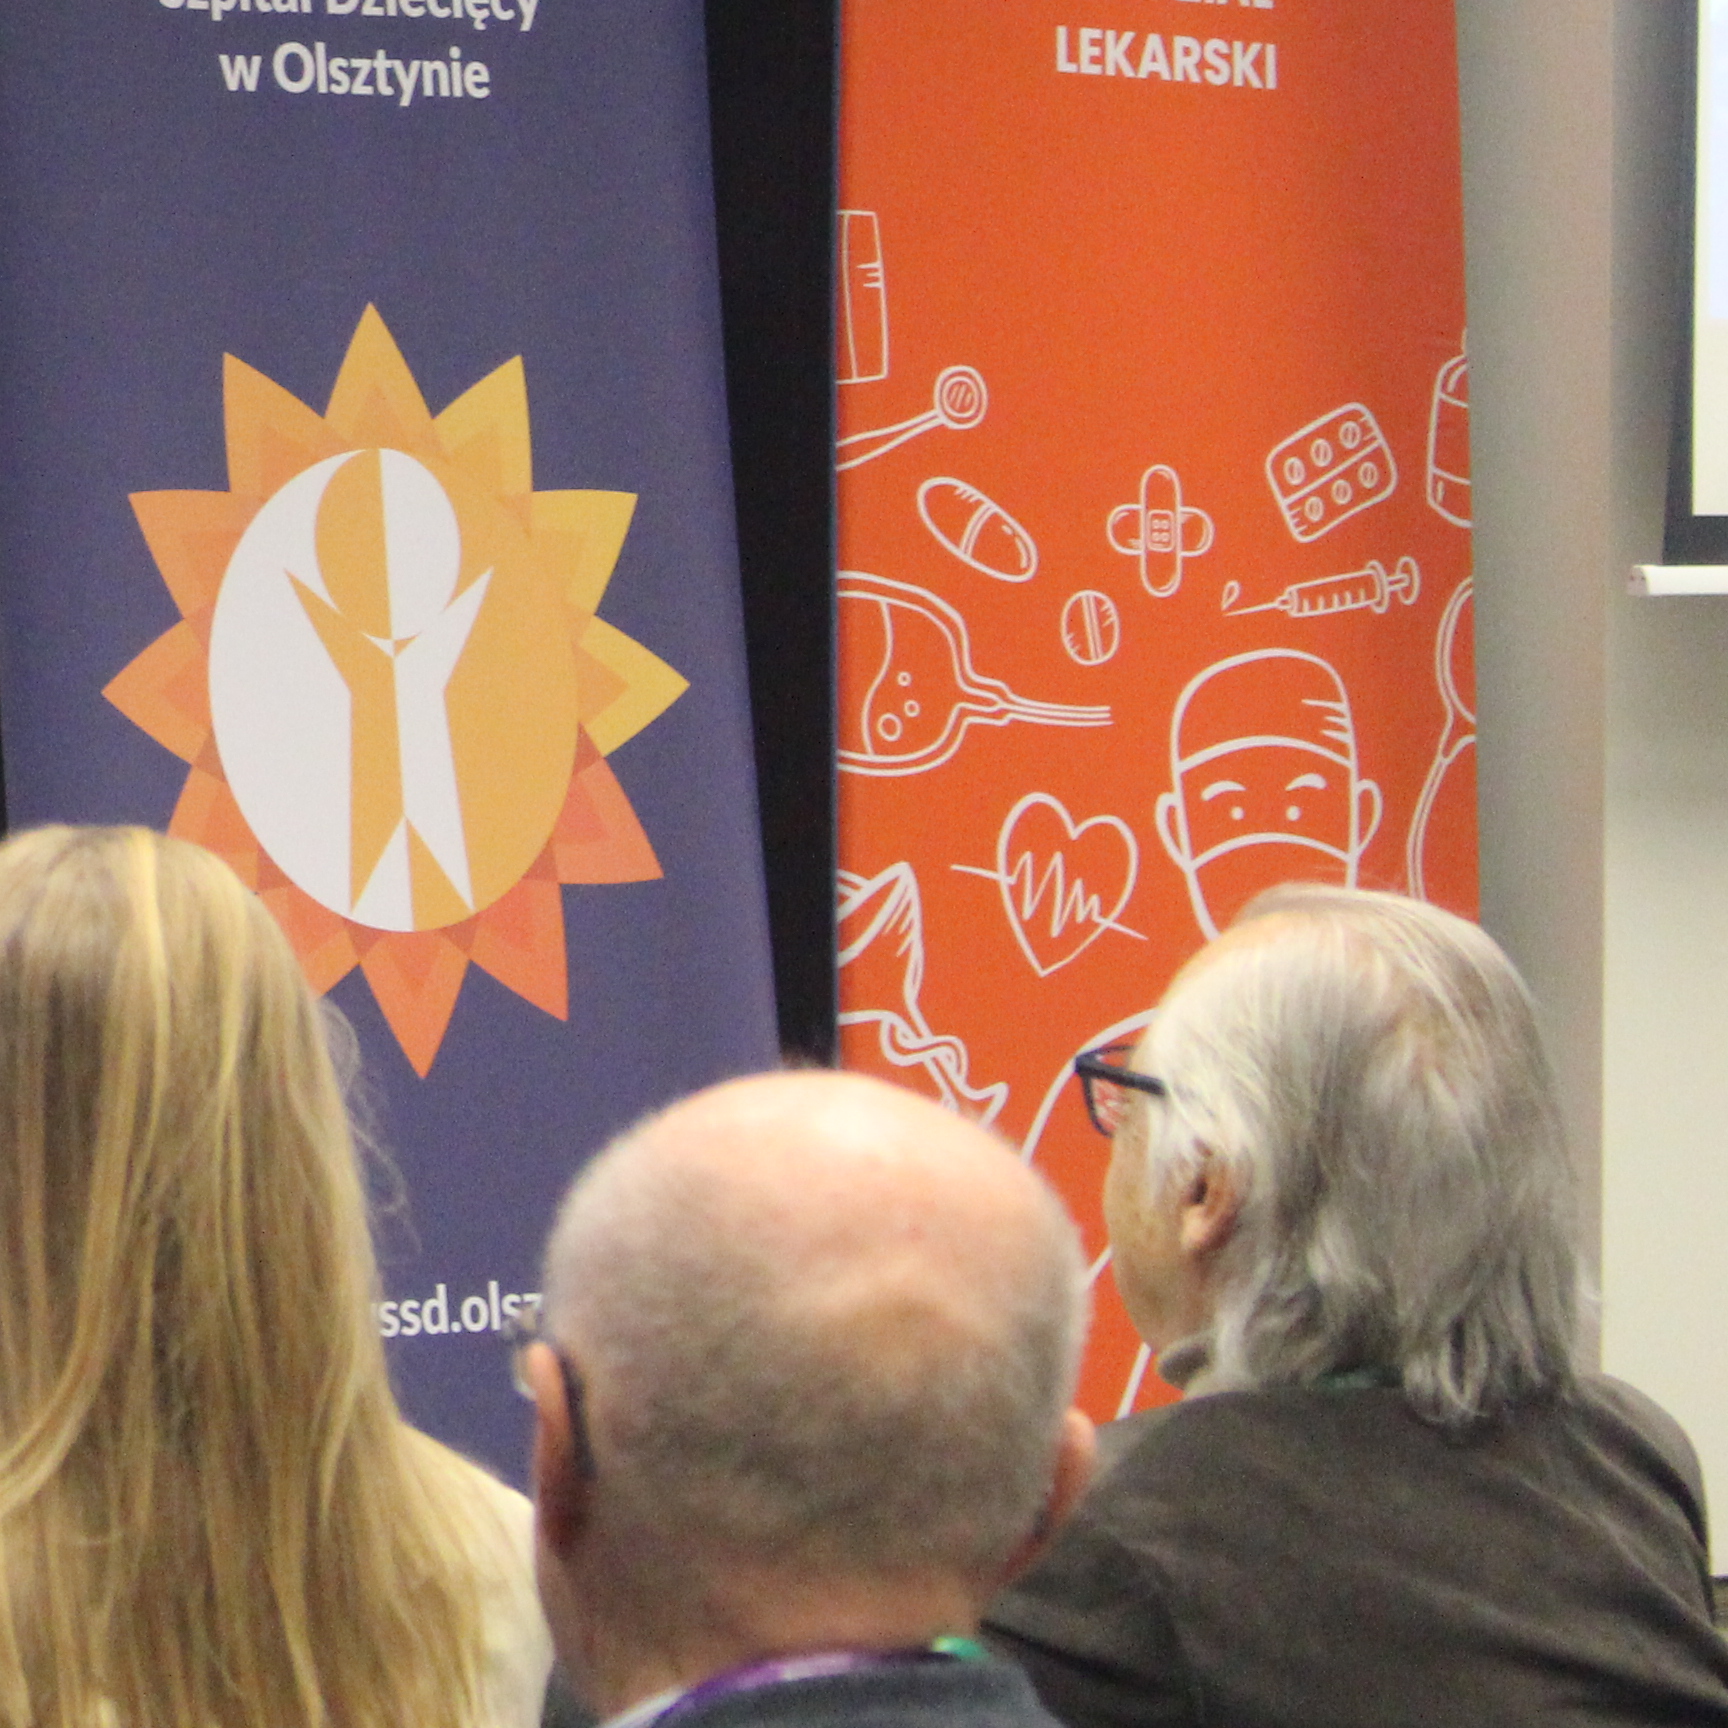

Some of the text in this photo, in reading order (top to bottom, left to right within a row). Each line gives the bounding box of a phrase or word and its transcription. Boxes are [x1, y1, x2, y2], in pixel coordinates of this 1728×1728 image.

[218, 41, 491, 107] w Olsztynie
[1056, 25, 1279, 90] LEKARSKI
